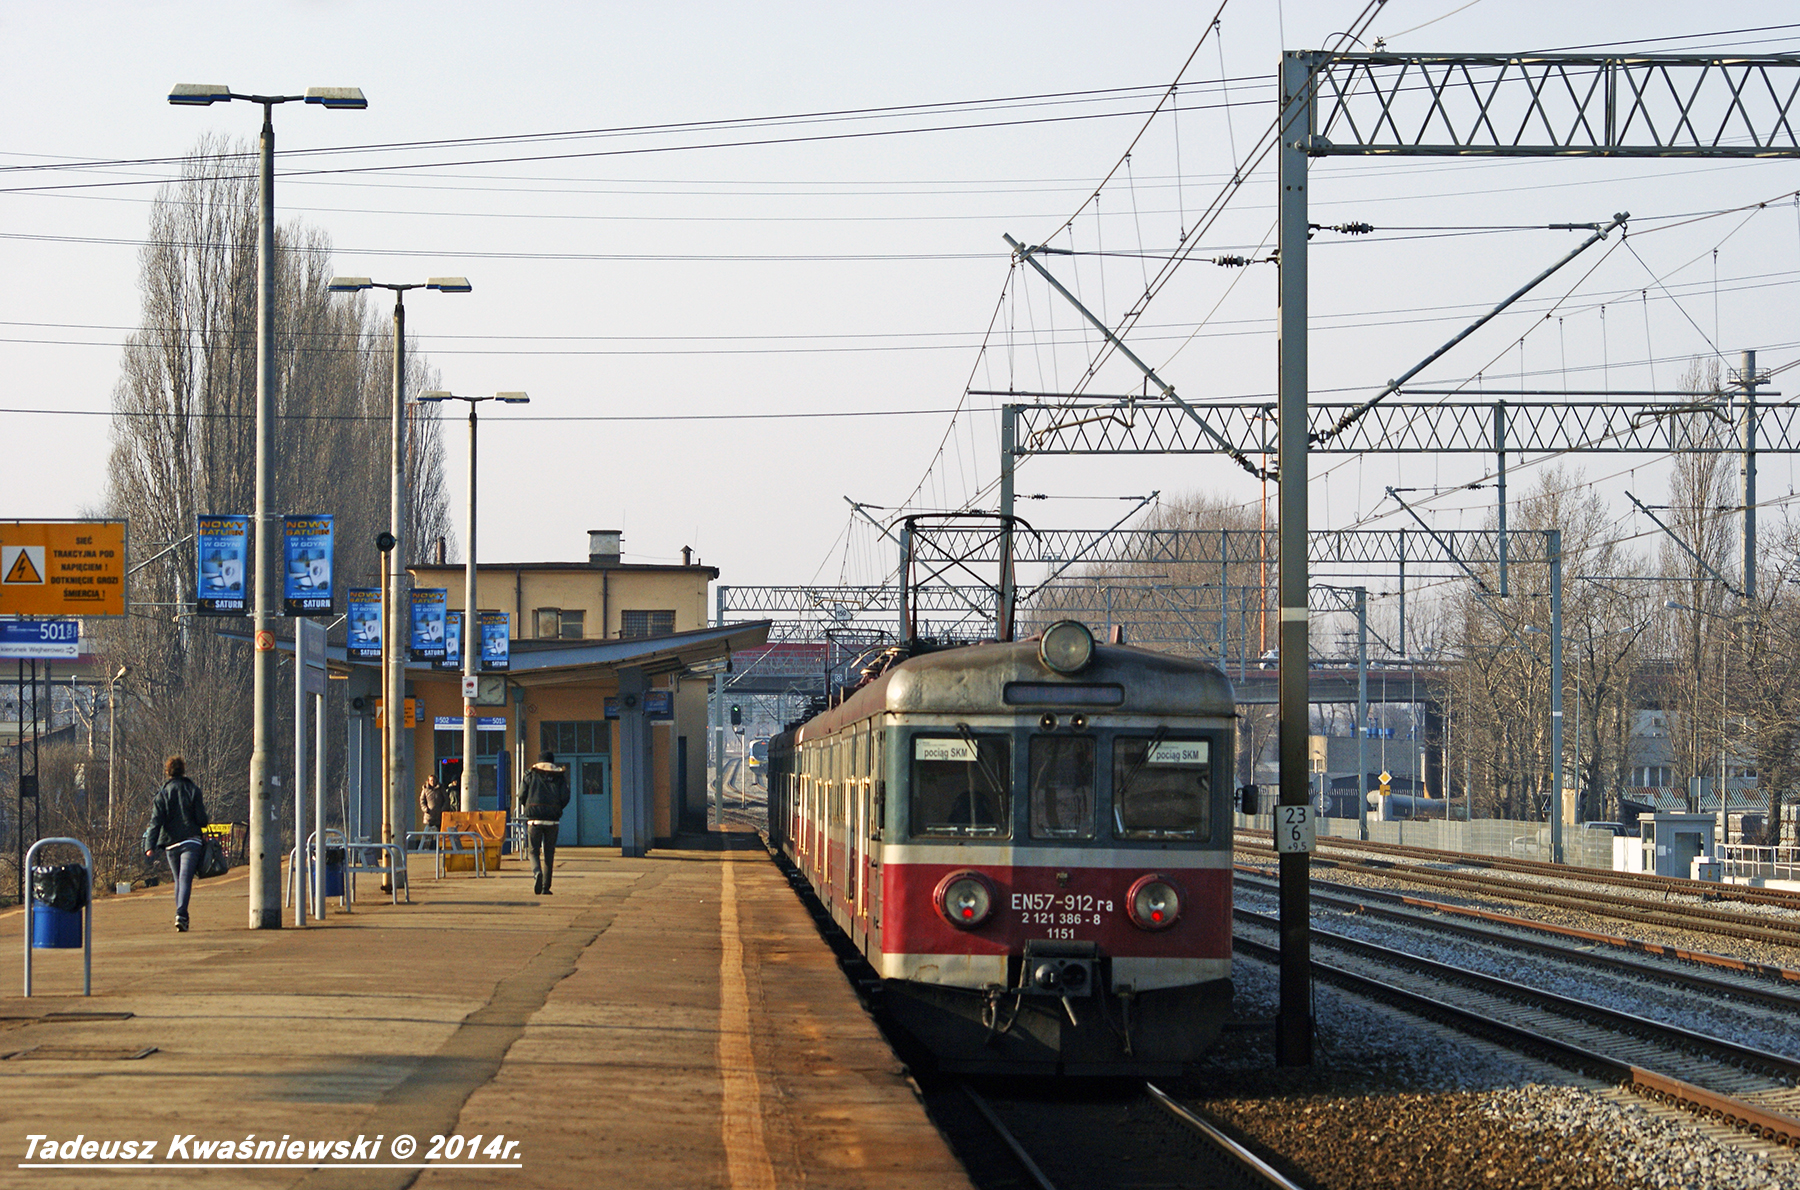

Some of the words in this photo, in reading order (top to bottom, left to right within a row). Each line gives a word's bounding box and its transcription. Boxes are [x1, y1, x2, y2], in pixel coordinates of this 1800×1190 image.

[200, 520, 245, 528] NOWY
[76, 535, 92, 544] SIEĆ
[54, 550, 97, 558] TRAKCYJNA
[99, 550, 114, 558] POD
[61, 564, 102, 572] NAPIĘCIEM
[51, 577, 94, 586] DOTKNIĘCIE
[63, 588, 100, 599] ŚMIERCIĄ
[215, 600, 243, 608] SATURN
[303, 599, 331, 608] SATURN
[40, 623, 66, 640] 501
[924, 748, 948, 760] pociąg
[951, 748, 968, 757] SKM
[1156, 750, 1180, 762] pociąg
[1182, 750, 1199, 760] SKM
[1286, 807, 1306, 824] 23
[1292, 825, 1301, 841] 6
[1012, 894, 1092, 911] EN57-912
[1097, 900, 1113, 912] ra
[1022, 913, 1029, 923] 2
[1034, 913, 1054, 923] 121
[1059, 914, 1081, 924] 386
[1093, 914, 1101, 925] 8
[1047, 928, 1074, 939] 1151
